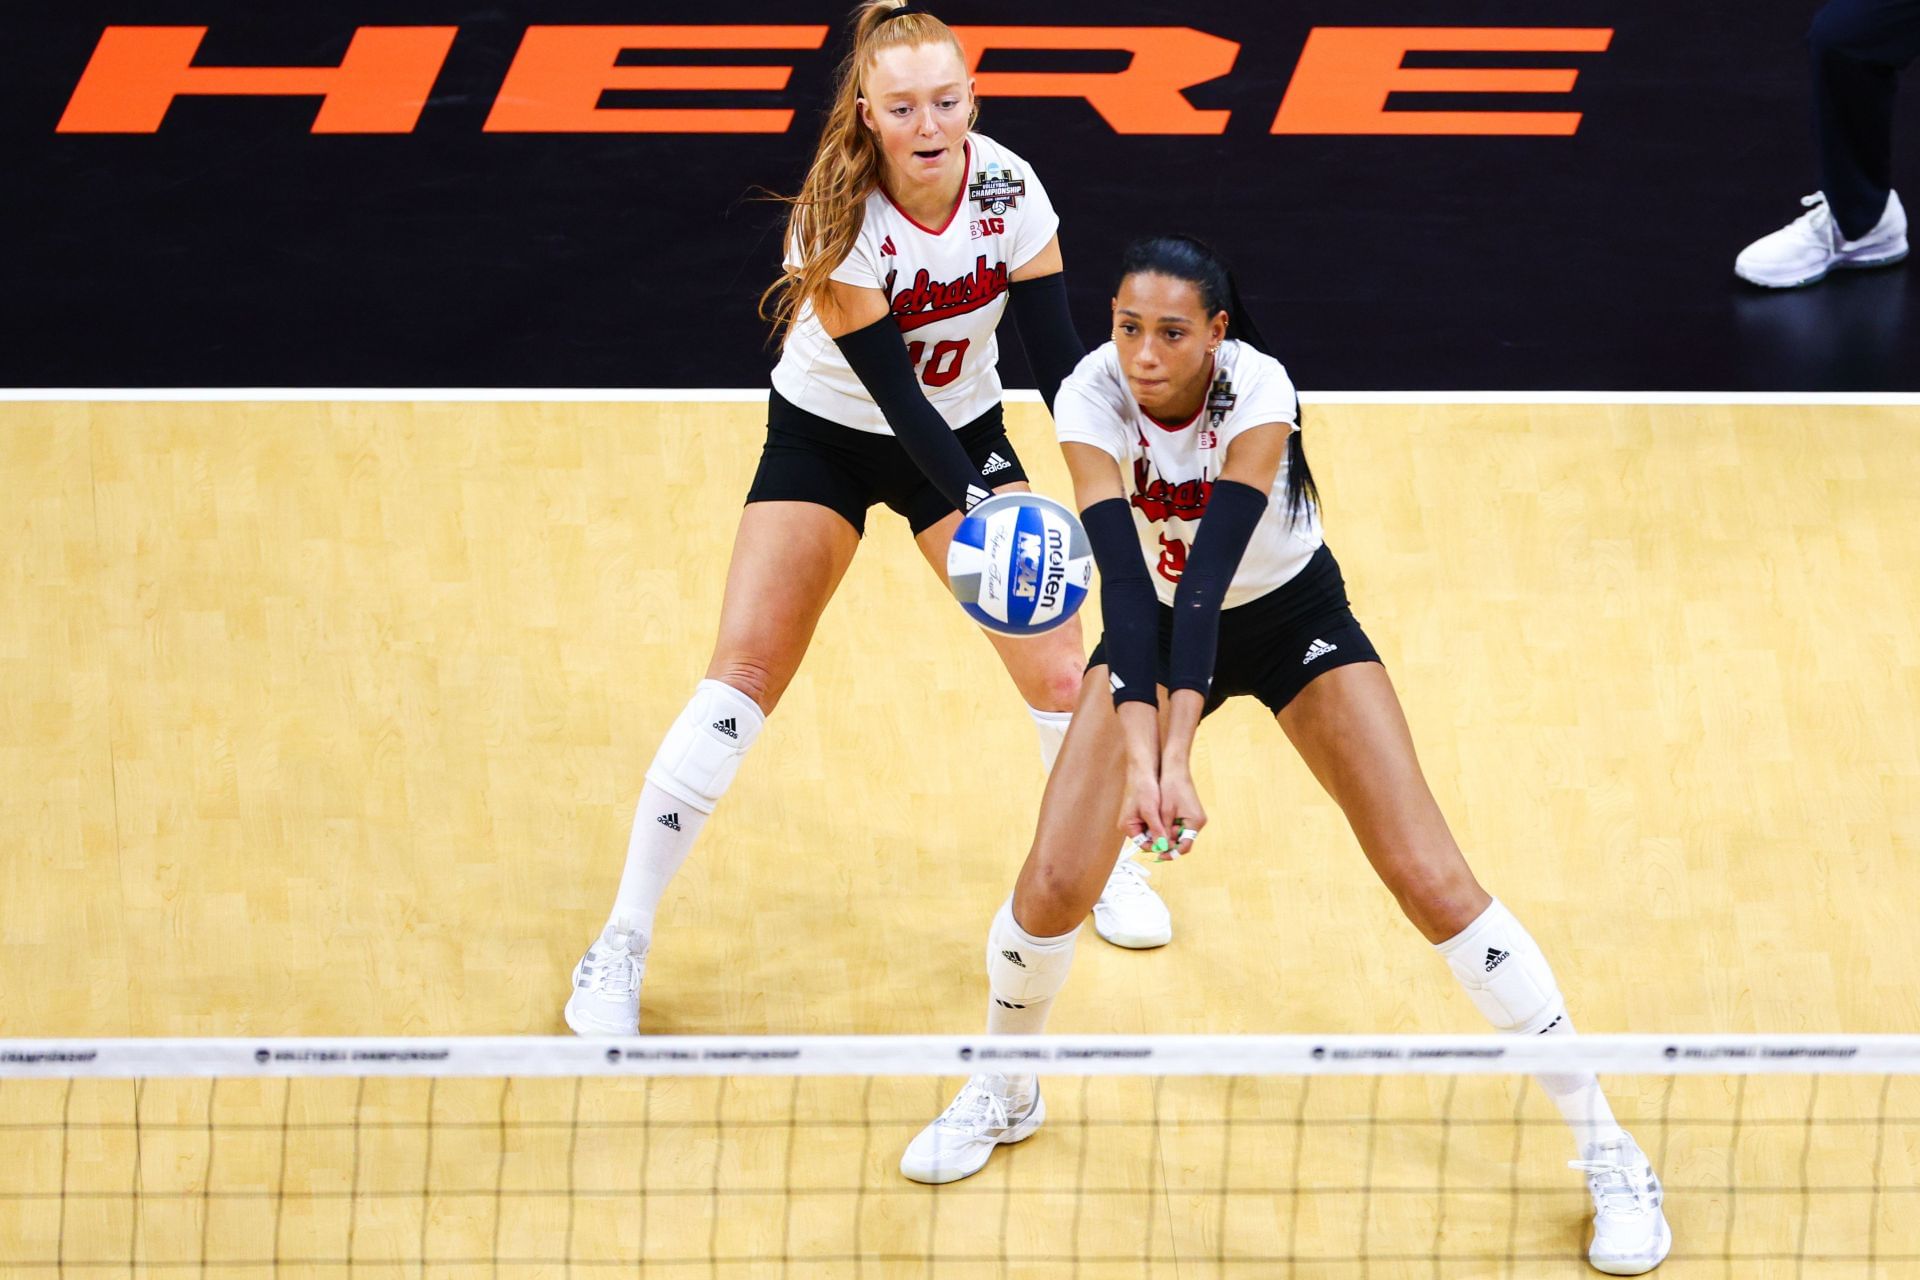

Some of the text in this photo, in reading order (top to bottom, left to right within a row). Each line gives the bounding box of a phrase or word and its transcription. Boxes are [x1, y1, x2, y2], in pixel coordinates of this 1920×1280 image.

[55, 26, 1614, 134] HERE
[971, 186, 1022, 198] CHAMPIONSHIP
[981, 460, 1012, 476] adidas
[1014, 530, 1042, 602] NCAA
[1041, 528, 1066, 608] molten
[712, 722, 739, 740] adidas
[656, 816, 681, 832] adidas
[1485, 950, 1511, 973] adidas
